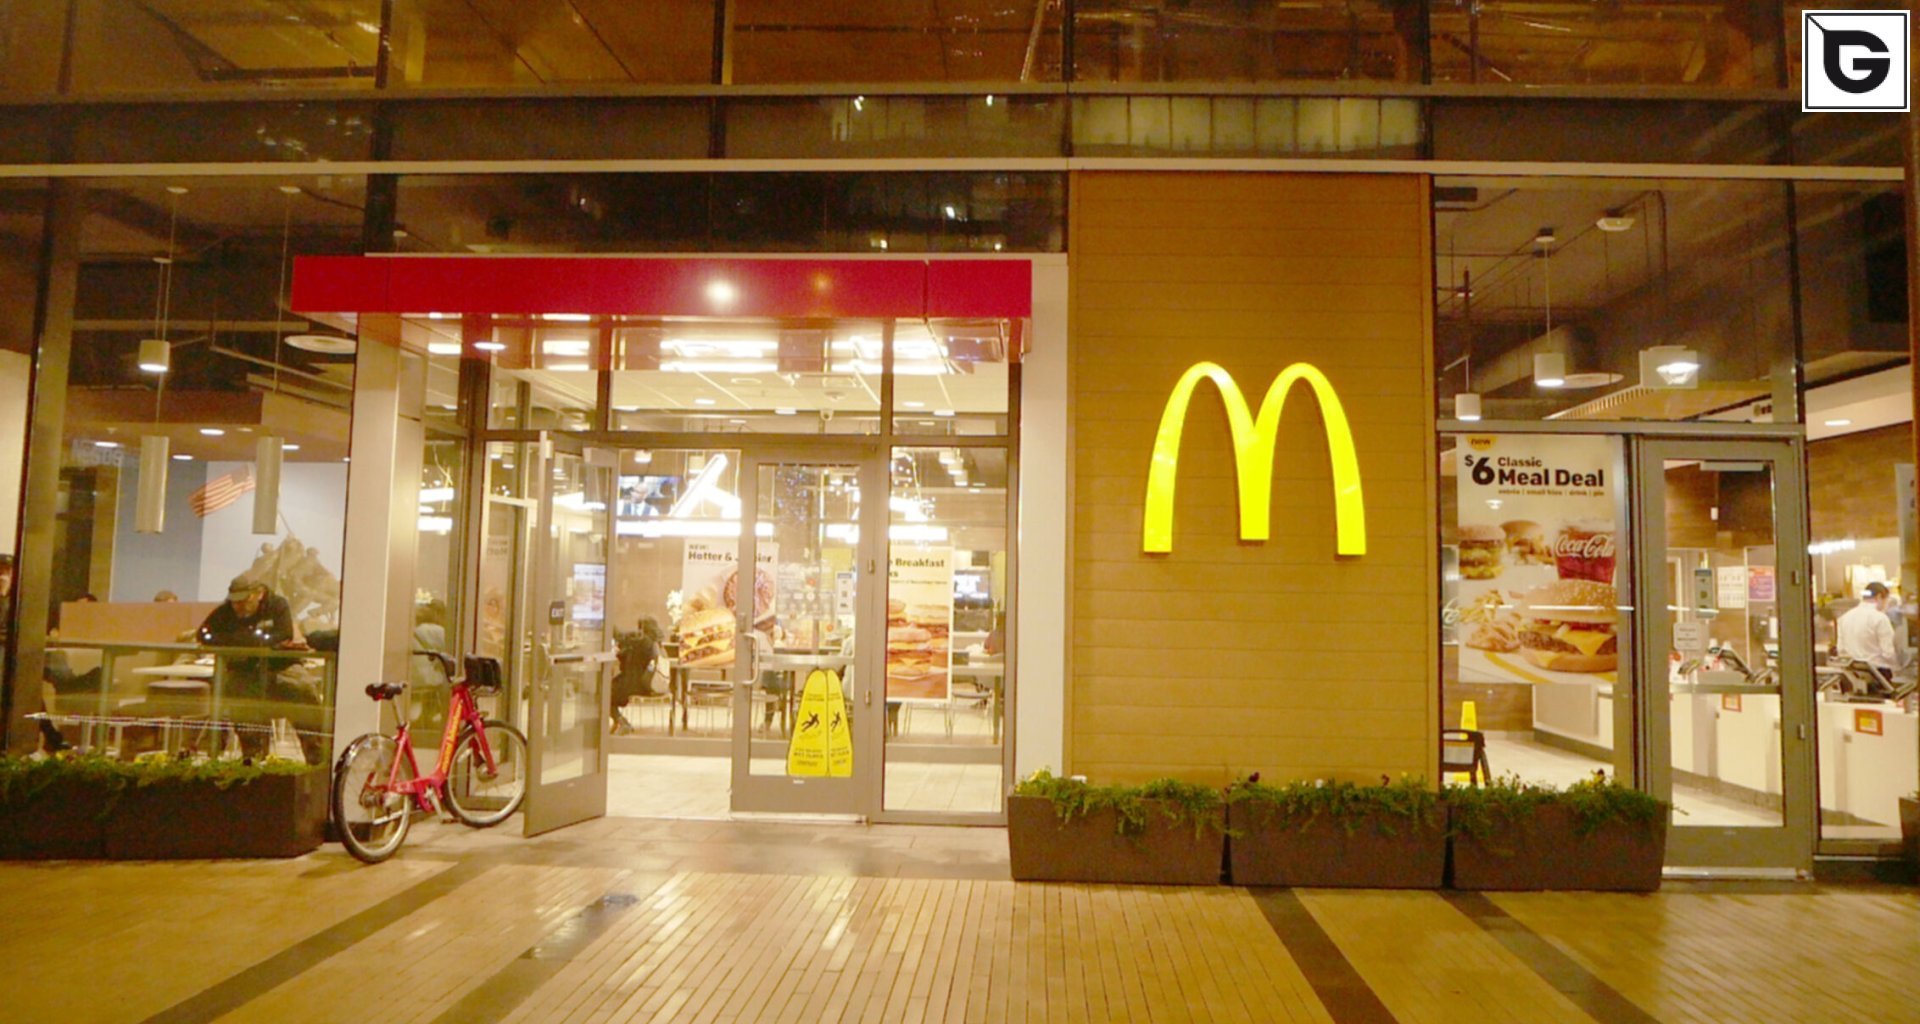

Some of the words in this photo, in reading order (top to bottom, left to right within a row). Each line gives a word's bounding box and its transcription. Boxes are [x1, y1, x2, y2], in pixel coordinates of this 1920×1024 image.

[1470, 437, 1491, 446] new
[1498, 456, 1542, 467] Classic
[1464, 454, 1496, 486] $6
[1498, 468, 1550, 486] Meal
[1555, 469, 1604, 487] Deal
[688, 551, 722, 560] Hotter
[895, 558, 945, 568] Breakfast
